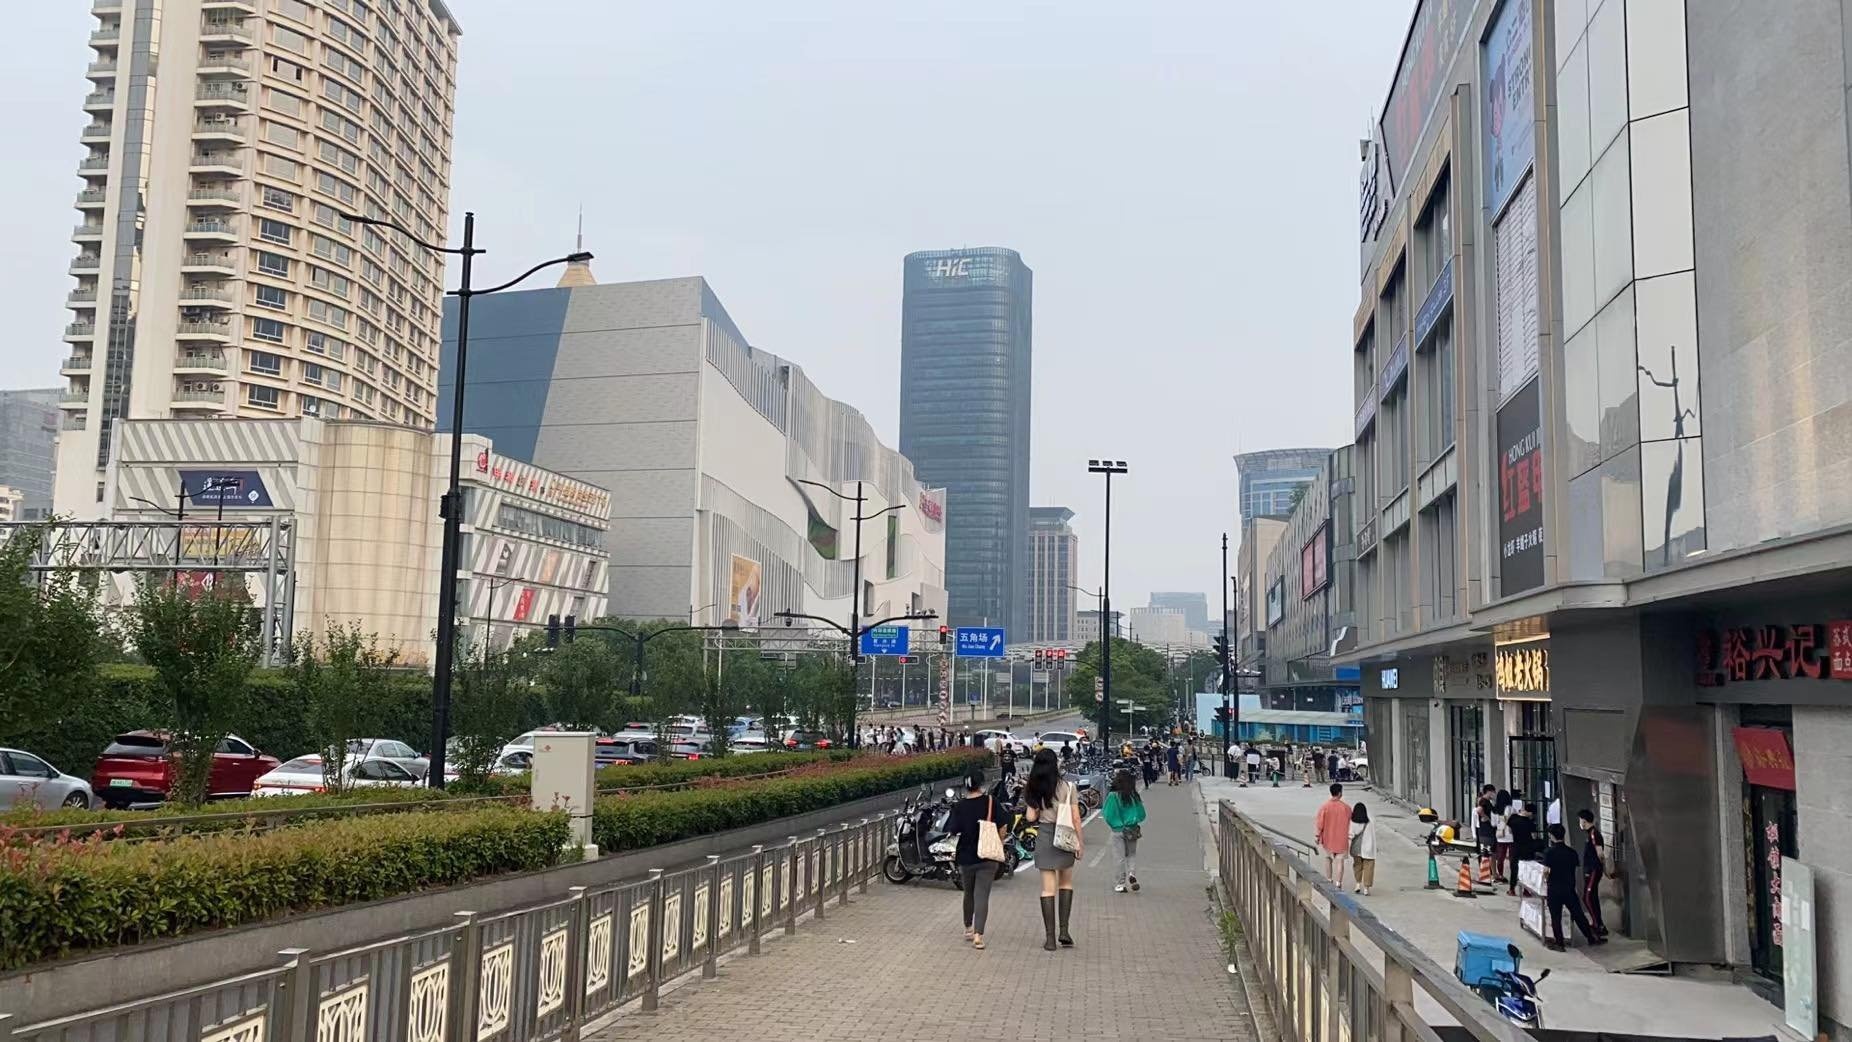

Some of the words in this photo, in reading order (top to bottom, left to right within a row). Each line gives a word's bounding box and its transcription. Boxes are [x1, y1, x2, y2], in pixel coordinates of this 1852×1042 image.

[1507, 41, 1531, 98] STRON
[1512, 66, 1531, 111] ENTR
[959, 632, 988, 643] 五角场
[1722, 624, 1821, 681] 裕兴记
